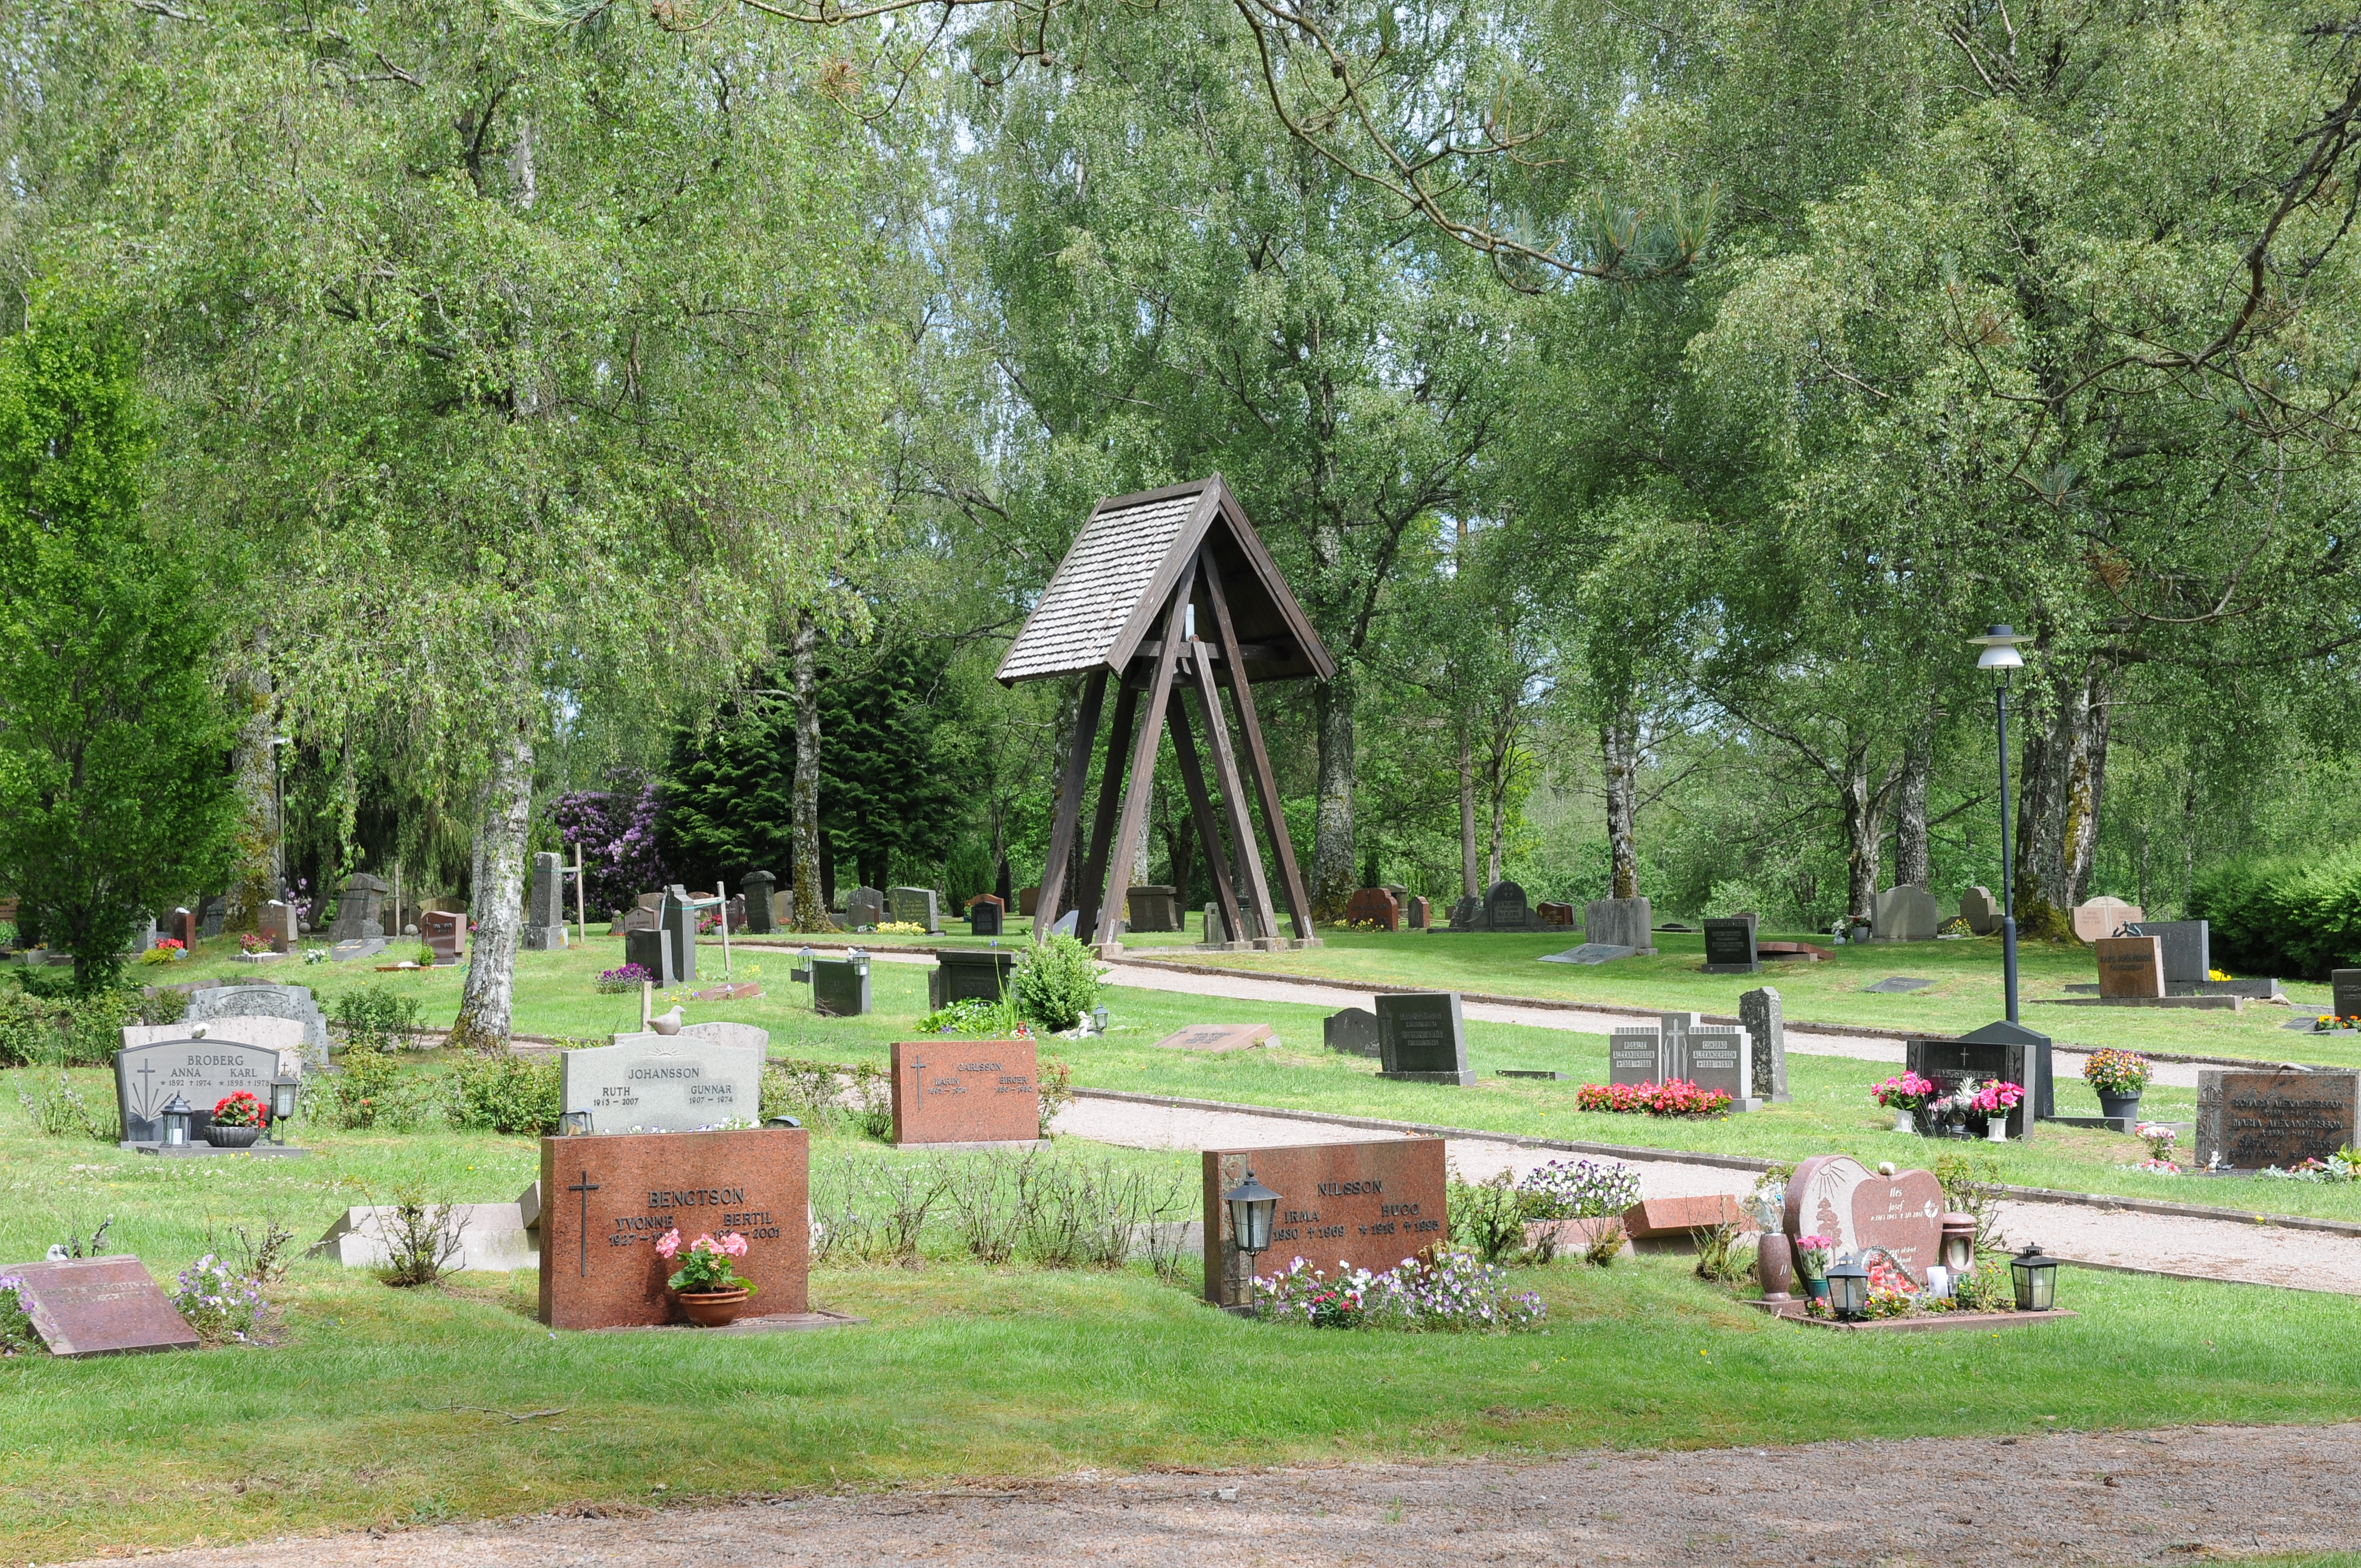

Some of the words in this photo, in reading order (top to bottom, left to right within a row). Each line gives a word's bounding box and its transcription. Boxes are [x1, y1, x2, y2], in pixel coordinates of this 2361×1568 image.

[188, 1055, 244, 1066] BROBERG
[171, 1068, 202, 1077] ANNA
[230, 1068, 257, 1077] KARL
[958, 1063, 1002, 1072] CARLSSON
[628, 1068, 699, 1079] JOHANSSON
[935, 1077, 959, 1086] KARIN
[999, 1075, 1029, 1084] BIRGER
[602, 1086, 631, 1096] RUTH
[690, 1085, 732, 1094] GUNNAR
[593, 1098, 610, 1106] 1913
[689, 1096, 705, 1104] 1907
[2232, 1099, 2270, 1108] RICHARD
[2274, 1099, 2344, 1109] ALEXANDERSSON
[2233, 1118, 2263, 1128] MARIA
[2268, 1119, 2343, 1129] ALEXANDERSSON
[1318, 1180, 1383, 1196] NILSSON
[648, 1188, 744, 1207] BENGTSON
[1888, 1200, 1905, 1213] Josef
[1285, 1210, 1320, 1223] IRMA
[1381, 1202, 1420, 1217] HUGO
[616, 1215, 674, 1231] YVONNE
[723, 1211, 773, 1226] BERTIL
[753, 1227, 780, 1239] 2001
[1319, 1224, 1346, 1238] 1969
[1414, 1219, 1439, 1232] 1995
[609, 1233, 637, 1246] 1927
